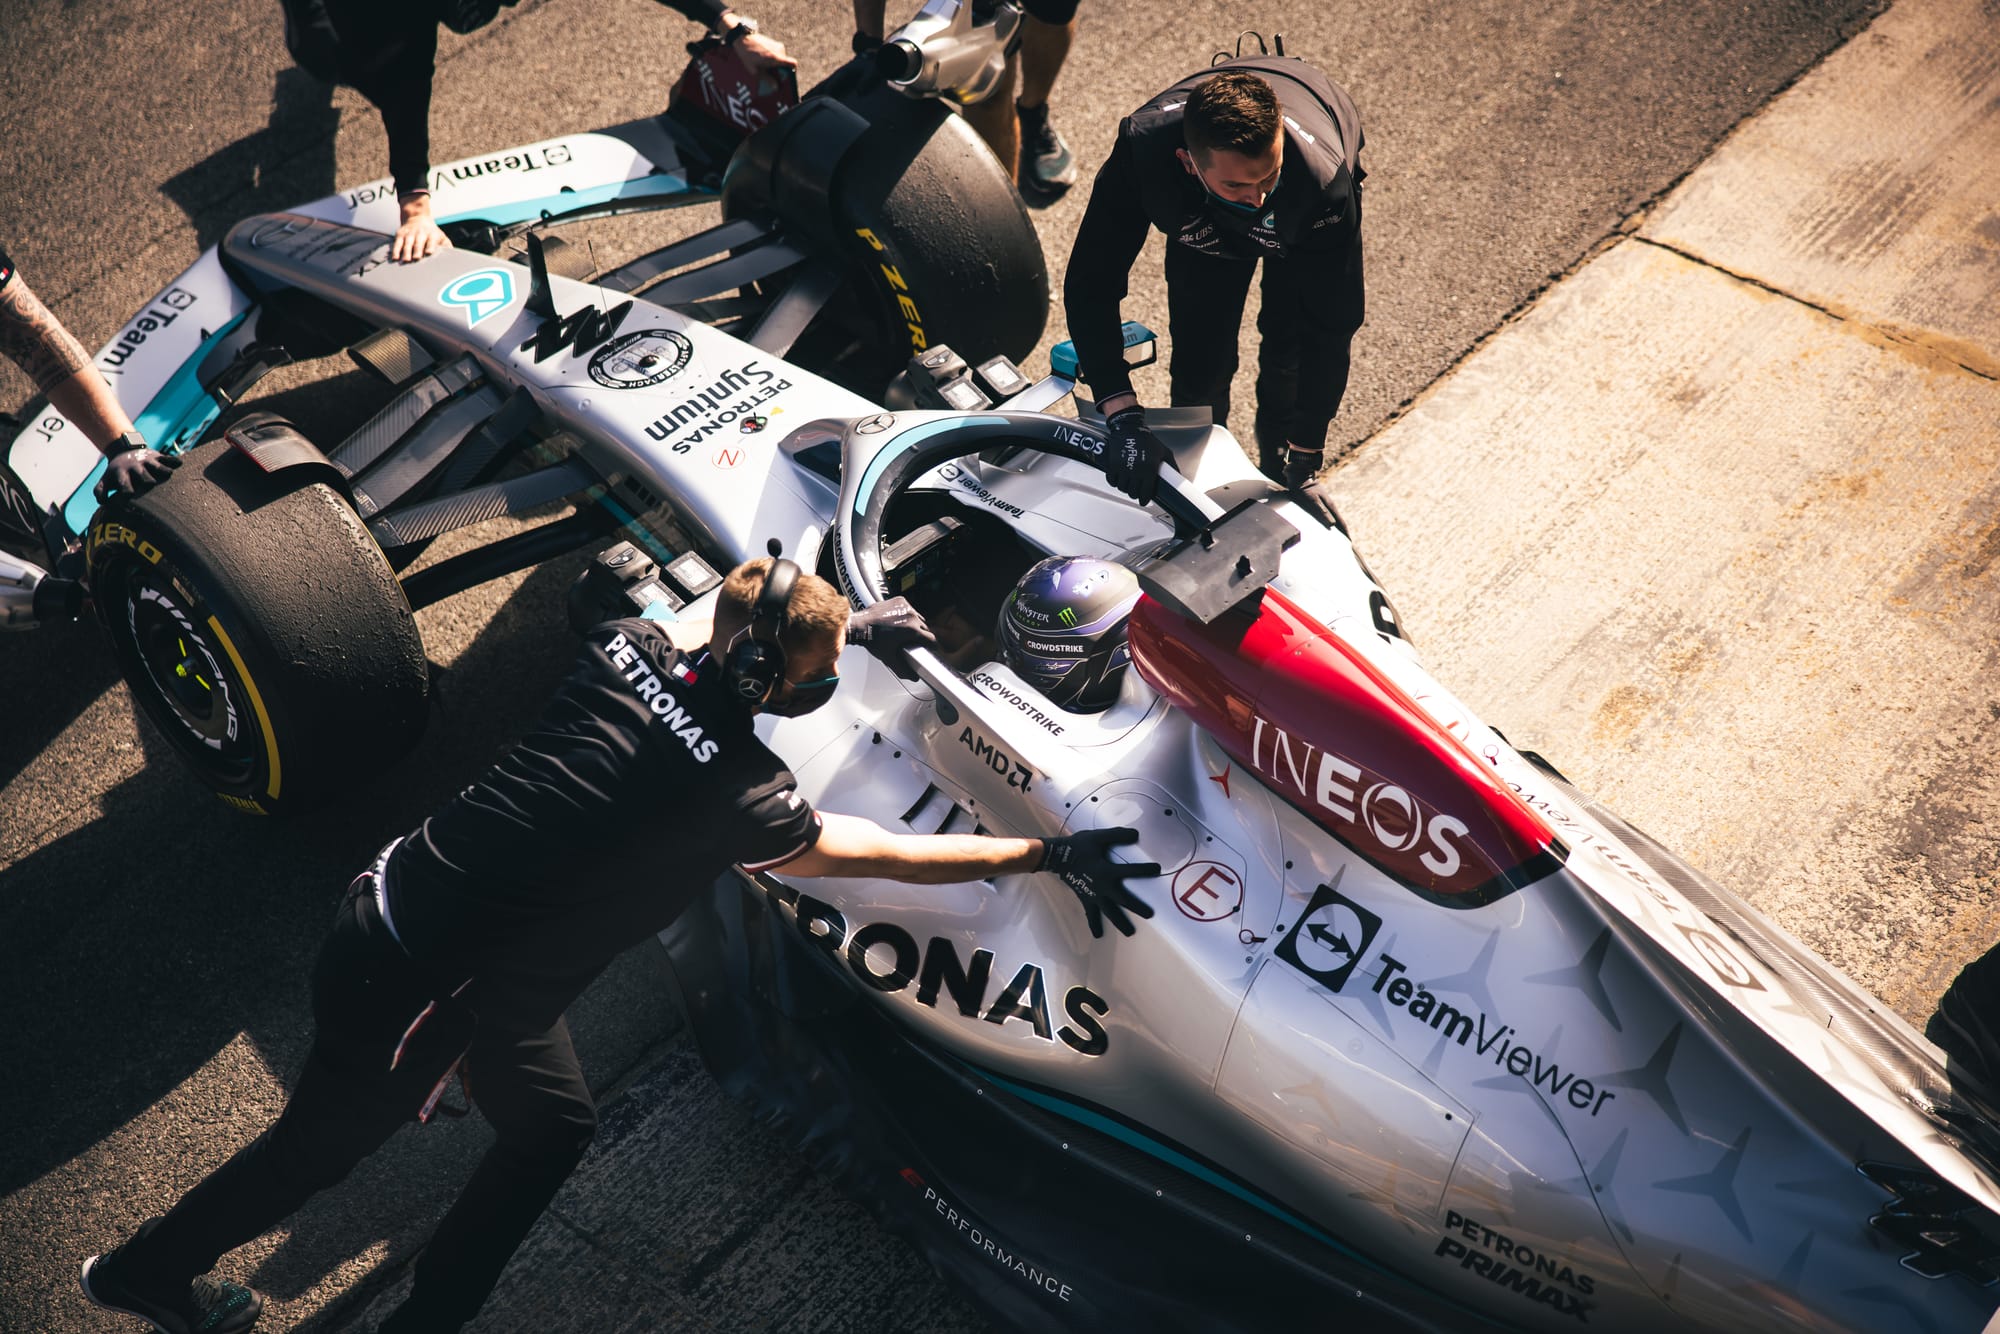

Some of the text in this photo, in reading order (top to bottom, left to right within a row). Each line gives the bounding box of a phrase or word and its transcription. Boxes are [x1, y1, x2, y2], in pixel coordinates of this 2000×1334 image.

[880, 263, 927, 358] ZER
[644, 361, 774, 441] Syntium
[671, 378, 793, 455] PETRONAS
[1052, 425, 1105, 455] INEOS
[958, 477, 1026, 520] TeamViewer
[93, 523, 163, 565] ZERO
[1027, 640, 1084, 653] CROWDSTRIKE
[604, 633, 719, 763] PETRONAS
[975, 672, 1065, 736] CROWDSTRIKE
[958, 726, 1010, 776] AMD
[1251, 715, 1470, 877] INEOS
[1179, 866, 1236, 917] E
[1371, 953, 1616, 1117] TeamViewer
[925, 1187, 1073, 1302] PERFORMANCE
[1434, 1236, 1597, 1325] PRIMAX
[1445, 1209, 1595, 1296] PETRONAS
